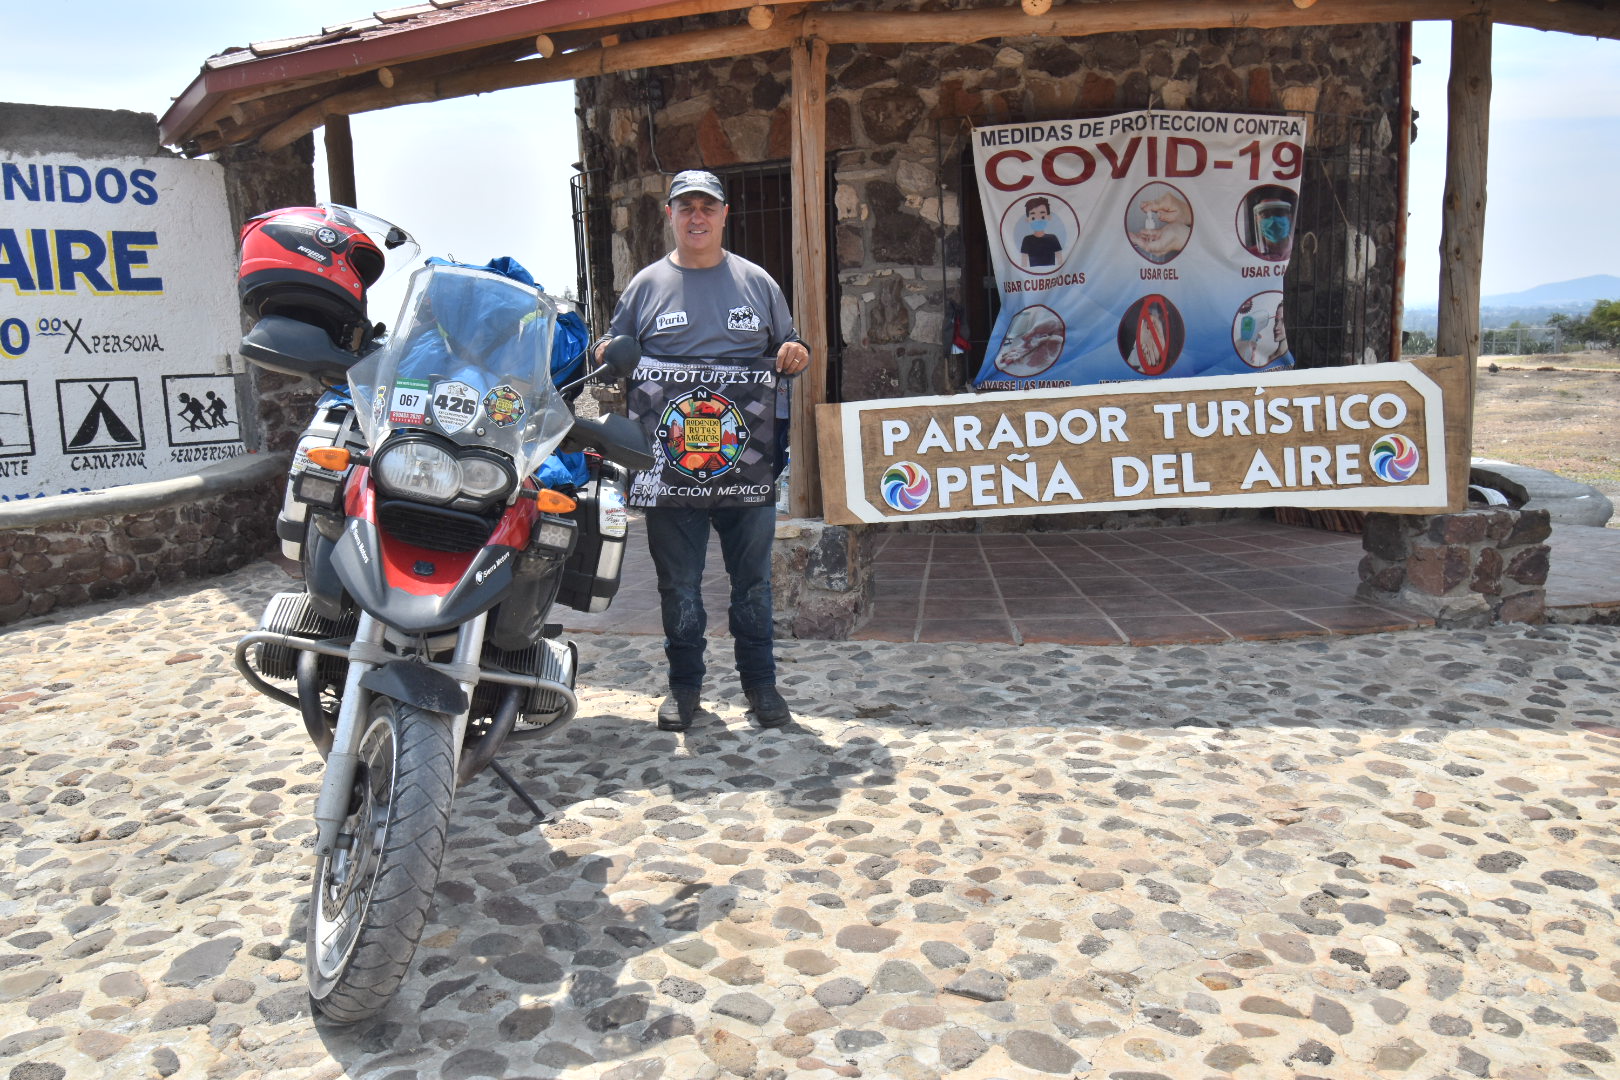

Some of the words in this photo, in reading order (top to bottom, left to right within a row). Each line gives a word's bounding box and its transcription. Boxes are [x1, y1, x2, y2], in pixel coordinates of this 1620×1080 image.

[981, 124, 1072, 147] MEDIDAS
[1079, 121, 1104, 140] DE
[1110, 114, 1228, 136] PROTECCION
[1233, 117, 1301, 136] CONTRA
[985, 136, 1302, 192] COVID-19
[2, 163, 158, 205] NIDOS
[0, 229, 164, 295] AIRE
[1140, 268, 1163, 280] USAR
[1163, 268, 1179, 280] GEL
[1241, 265, 1270, 278] USAR
[1003, 280, 1022, 293] USAR
[658, 314, 685, 327] Paris
[62, 318, 92, 354] X
[91, 333, 164, 353] PERSONA
[632, 367, 772, 384] MOTOTURISTA
[1018, 379, 1035, 391] LAS
[1038, 380, 1071, 389] MANOS
[399, 393, 420, 407] 067
[697, 391, 707, 399] N
[434, 394, 476, 415] 426
[882, 407, 1130, 456] PARADOR
[1153, 385, 1407, 440] TURÍSTICO
[71, 452, 147, 471] CAMPING
[170, 444, 245, 463] SENDERISMO
[936, 452, 1084, 508] PEÑA
[1111, 452, 1210, 497] DEL
[1240, 444, 1363, 489] AIRE
[633, 483, 653, 495] EN
[658, 484, 713, 497] ACCIÓN
[717, 483, 771, 496] MÉXICO
[483, 563, 497, 578] Sierra
